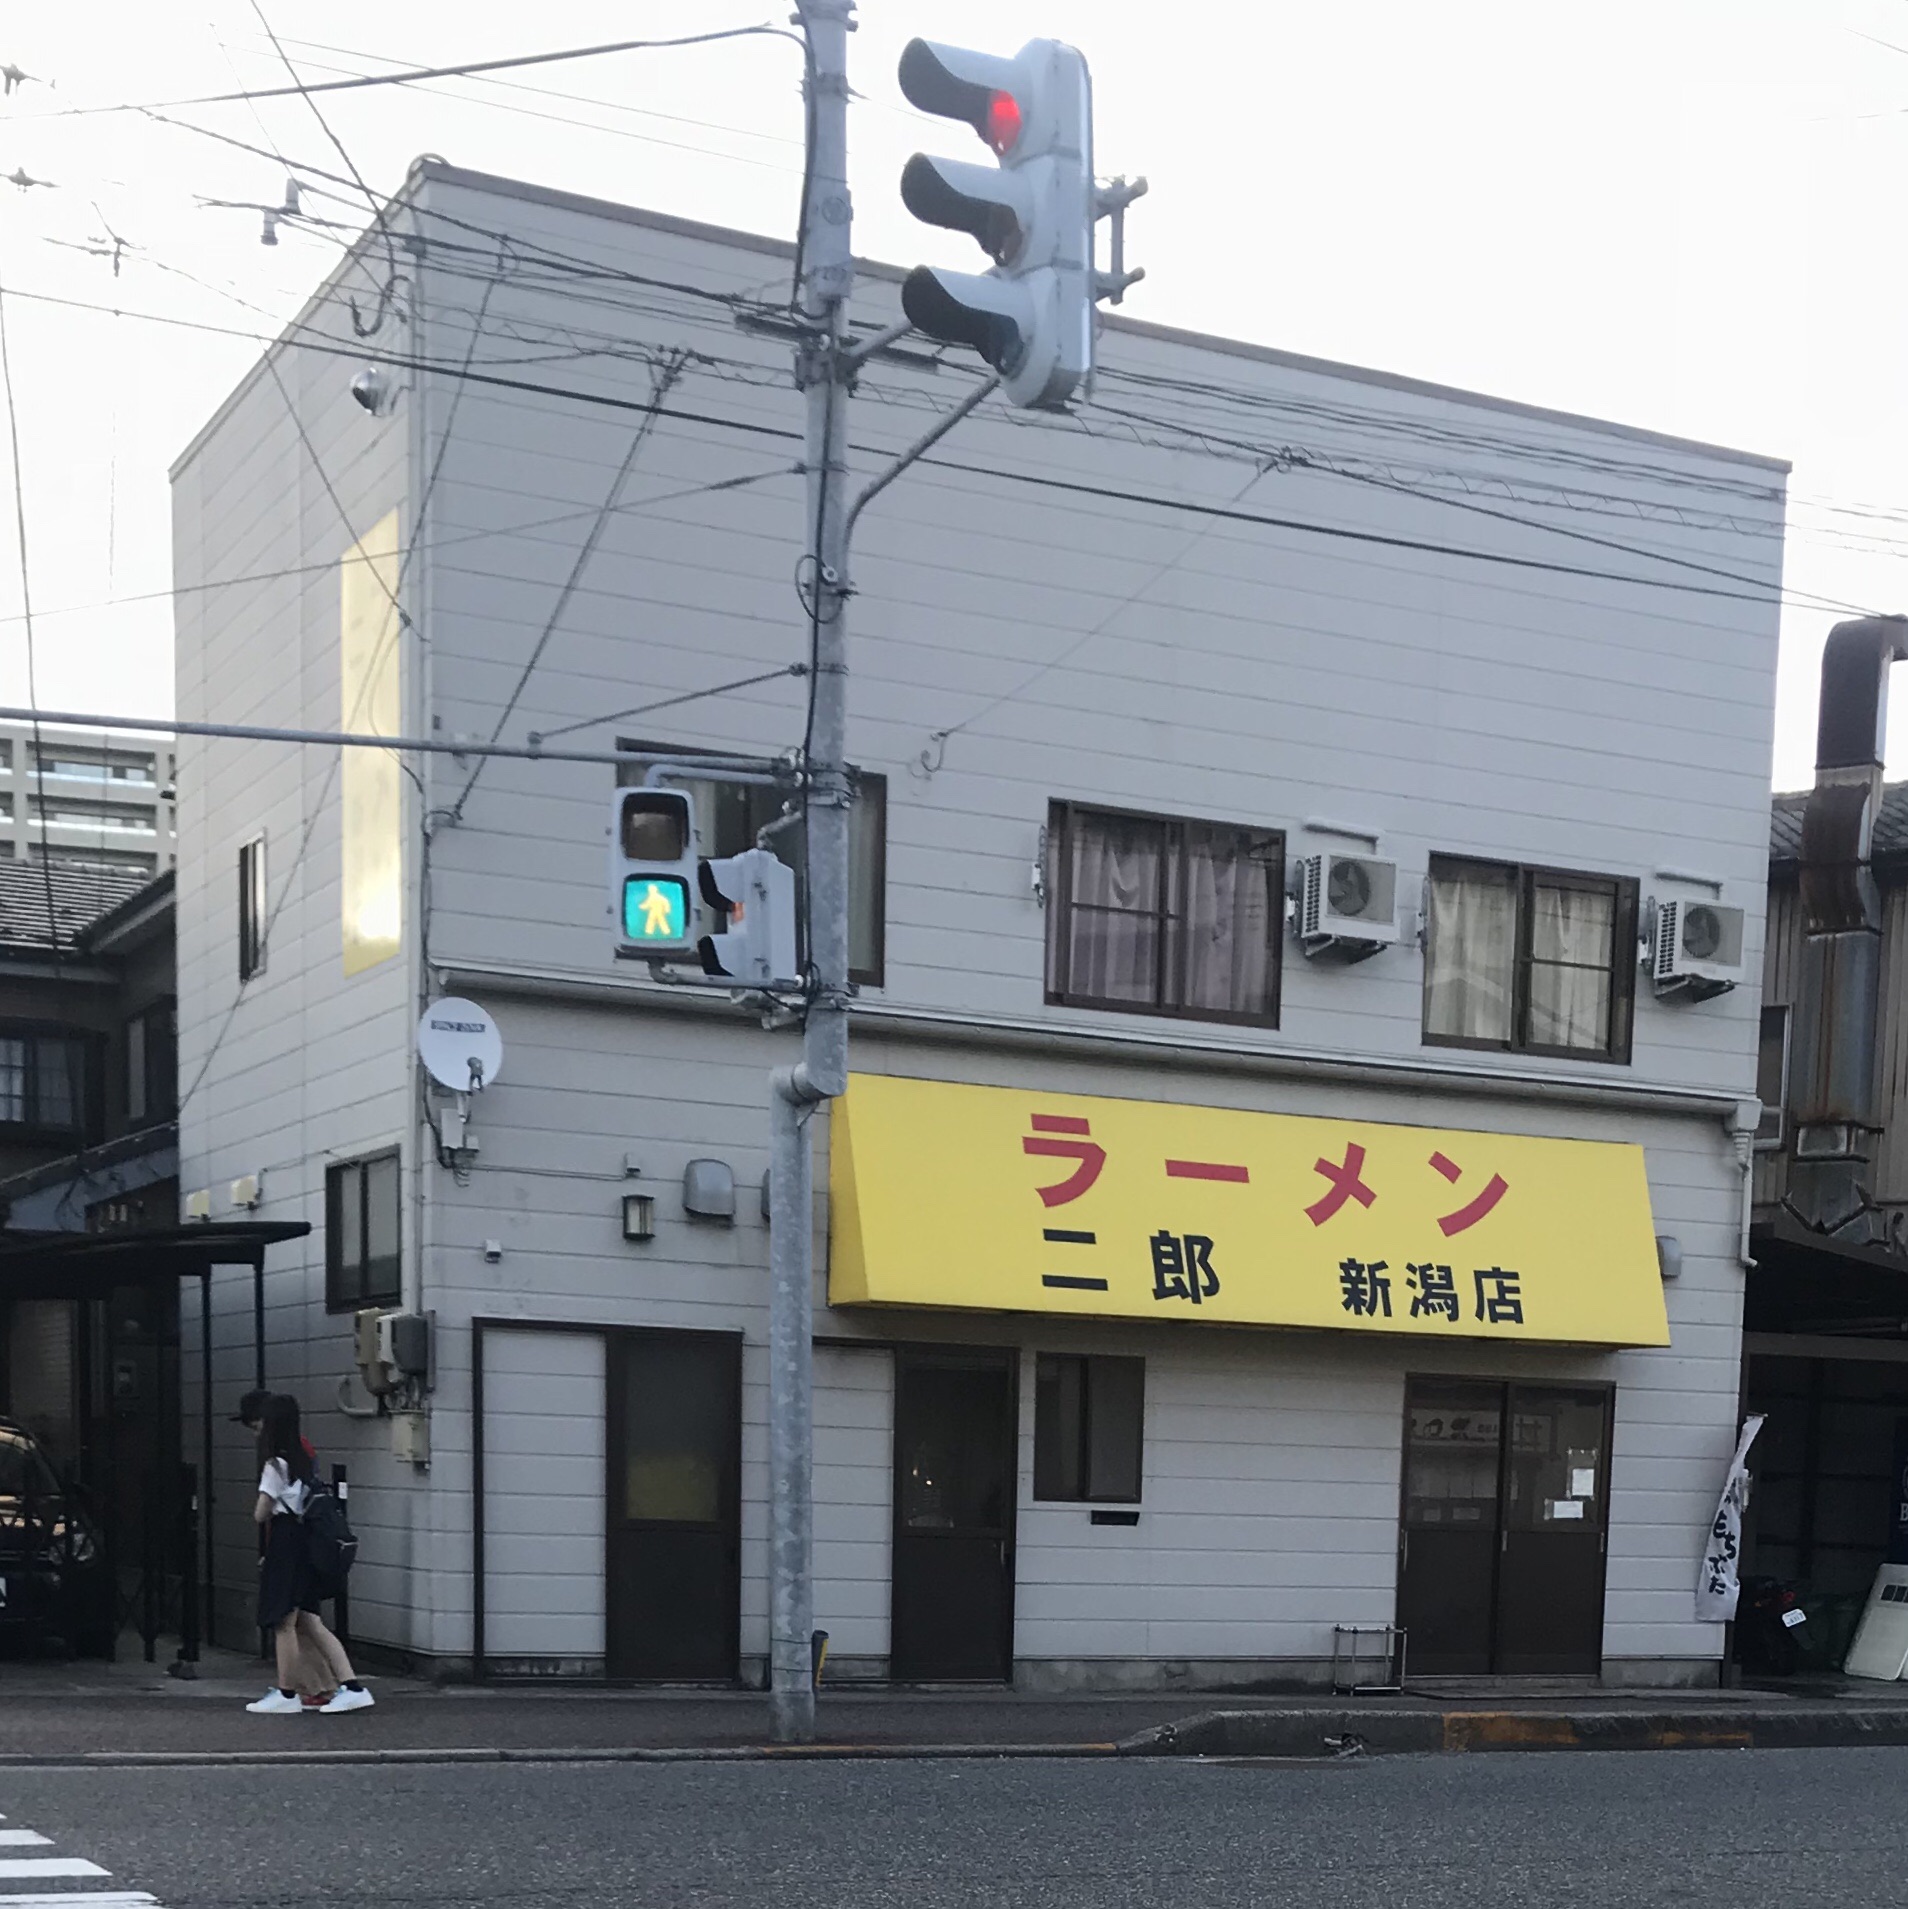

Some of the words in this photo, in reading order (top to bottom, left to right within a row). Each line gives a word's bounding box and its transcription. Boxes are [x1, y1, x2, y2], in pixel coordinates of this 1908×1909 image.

[1022, 1113, 1508, 1237] ラーメン
[1042, 1229, 1220, 1304] 二郎
[1338, 1258, 1523, 1325] 新潟店
[1708, 1478, 1739, 1595] もちぶた
